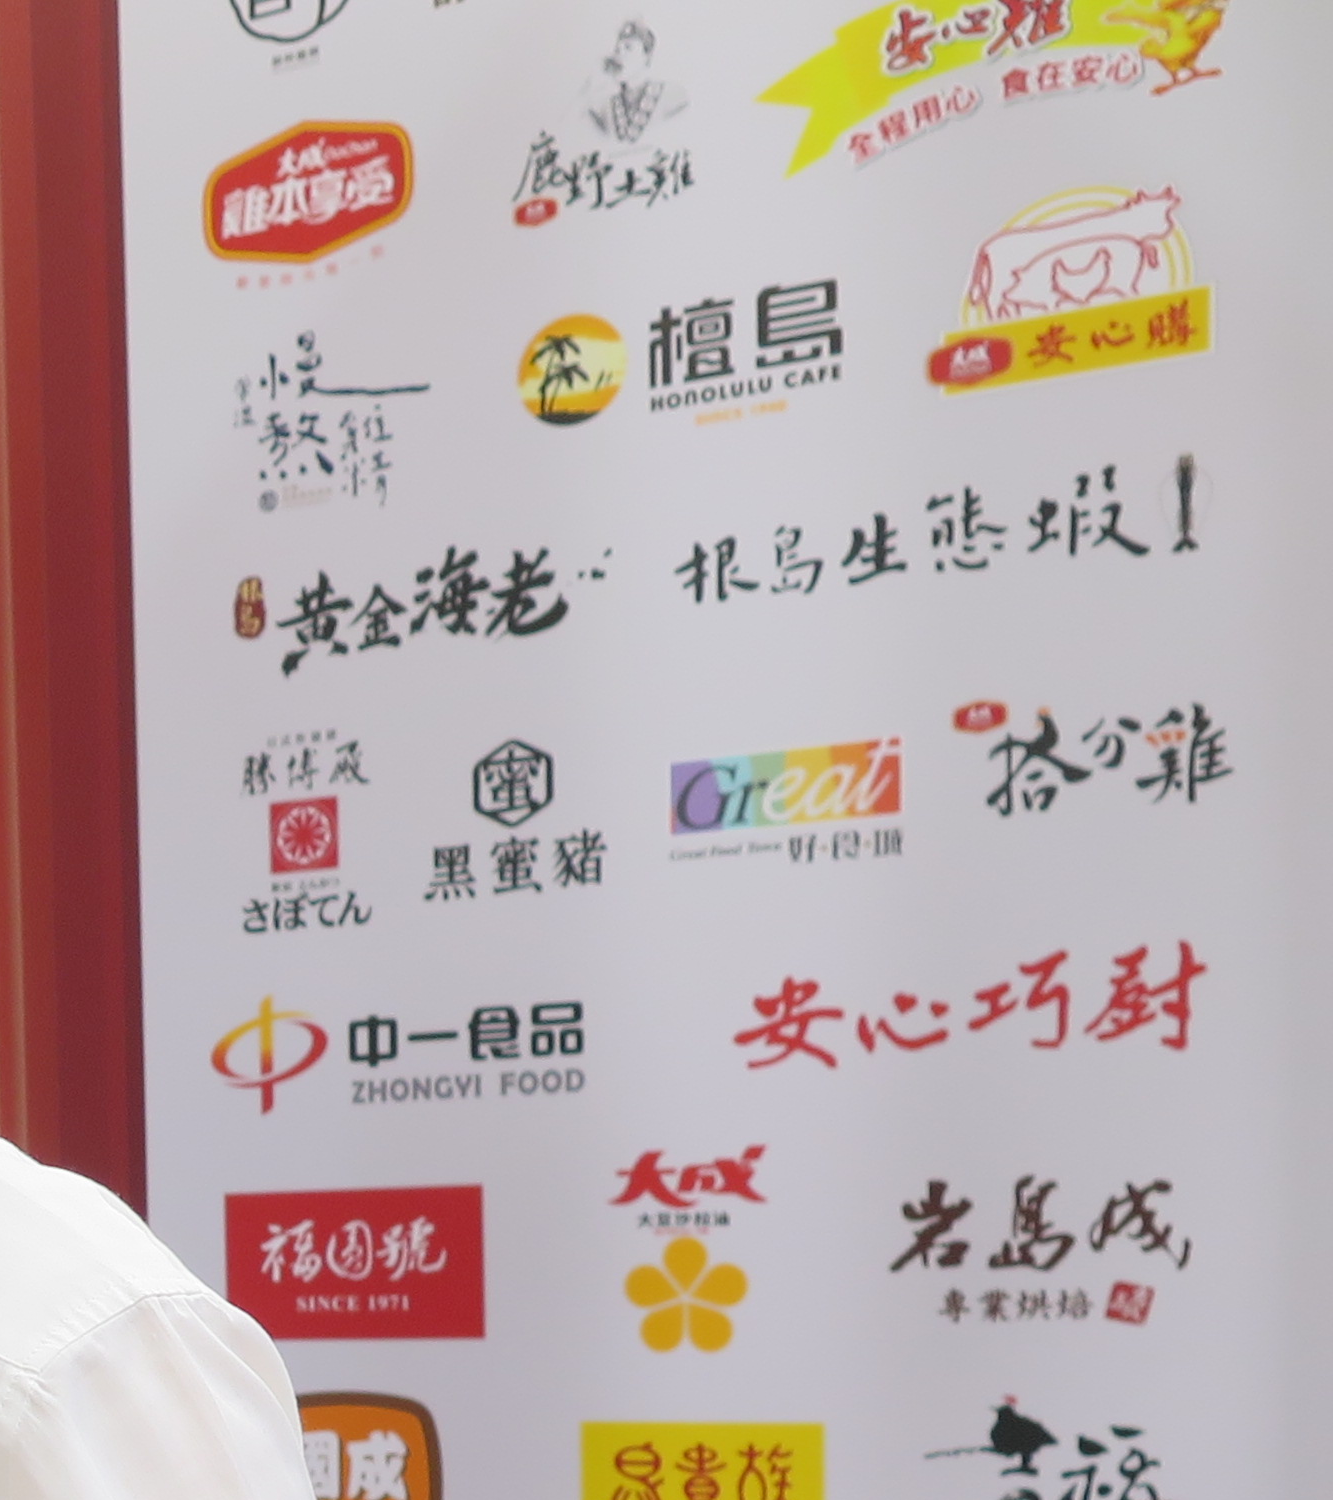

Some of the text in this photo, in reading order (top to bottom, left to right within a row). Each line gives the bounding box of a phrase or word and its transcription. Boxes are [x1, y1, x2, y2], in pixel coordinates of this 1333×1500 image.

[848, 51, 1140, 163] 全程用心 食在安心
[649, 278, 843, 390] 檀島
[783, 362, 843, 389] CAFE
[276, 546, 569, 677] 黃金海老
[674, 736, 902, 832] Great
[424, 829, 607, 902] 黑蜜豬
[242, 893, 372, 934] さぼてん
[348, 1002, 582, 1066] 中一食品
[733, 941, 1207, 1069] 安心巧廚
[352, 1069, 585, 1104] ZHONGYI FOOD
[609, 1145, 767, 1207] 大成
[296, 1293, 410, 1312] SINCE 1971
